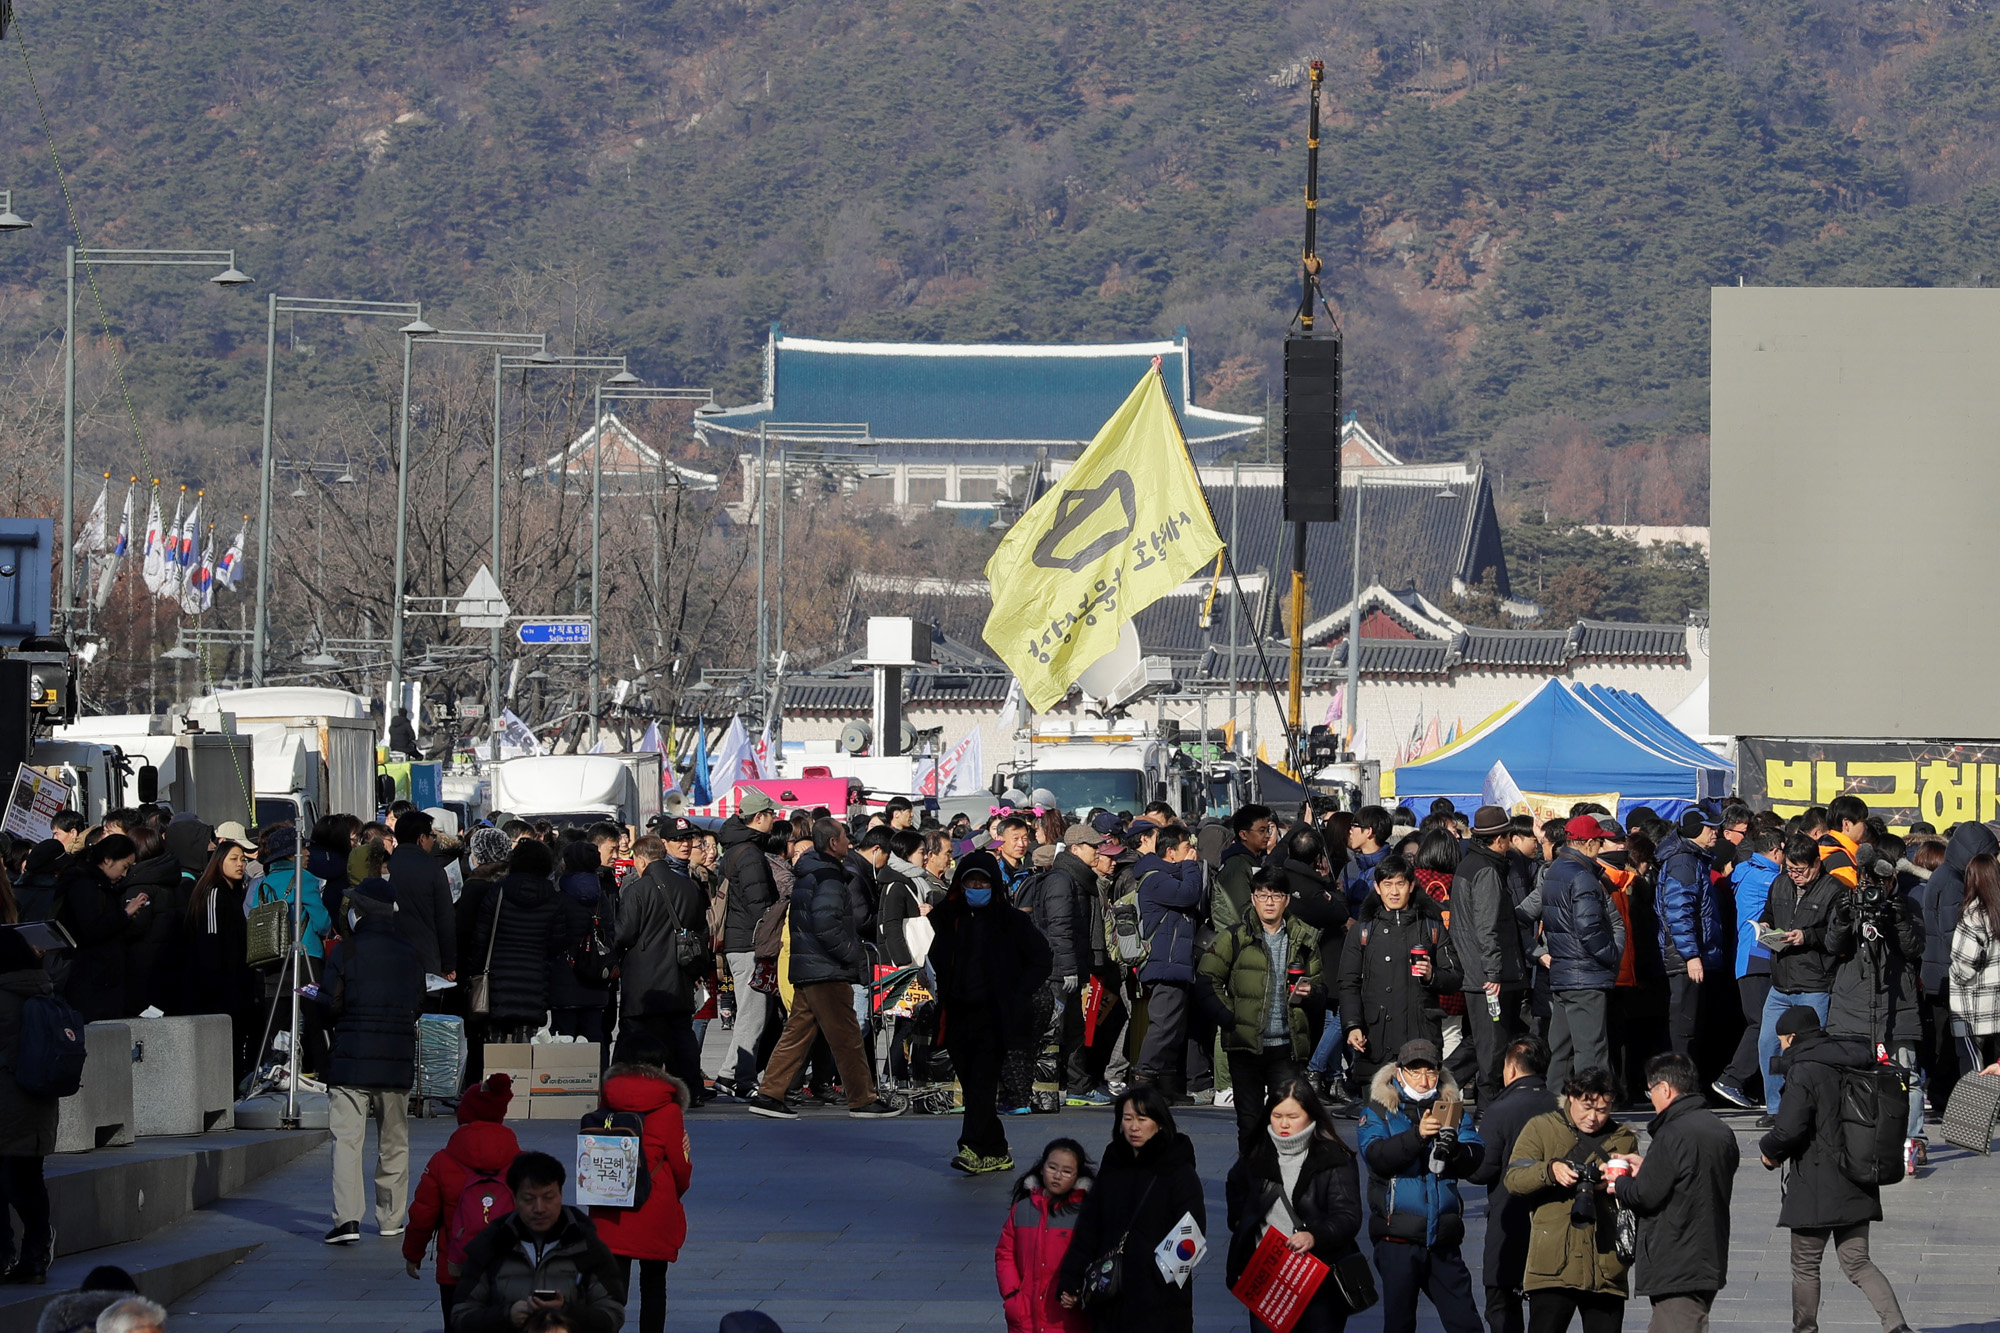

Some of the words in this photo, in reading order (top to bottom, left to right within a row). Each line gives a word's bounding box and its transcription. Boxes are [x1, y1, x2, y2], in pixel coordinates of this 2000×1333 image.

[548, 625, 588, 635] 사직로8길
[549, 635, 573, 643] Sajik-ro
[1765, 758, 2000, 835] 박근혜
[593, 1157, 624, 1169] 박근혜
[597, 1169, 621, 1182] 구속!
